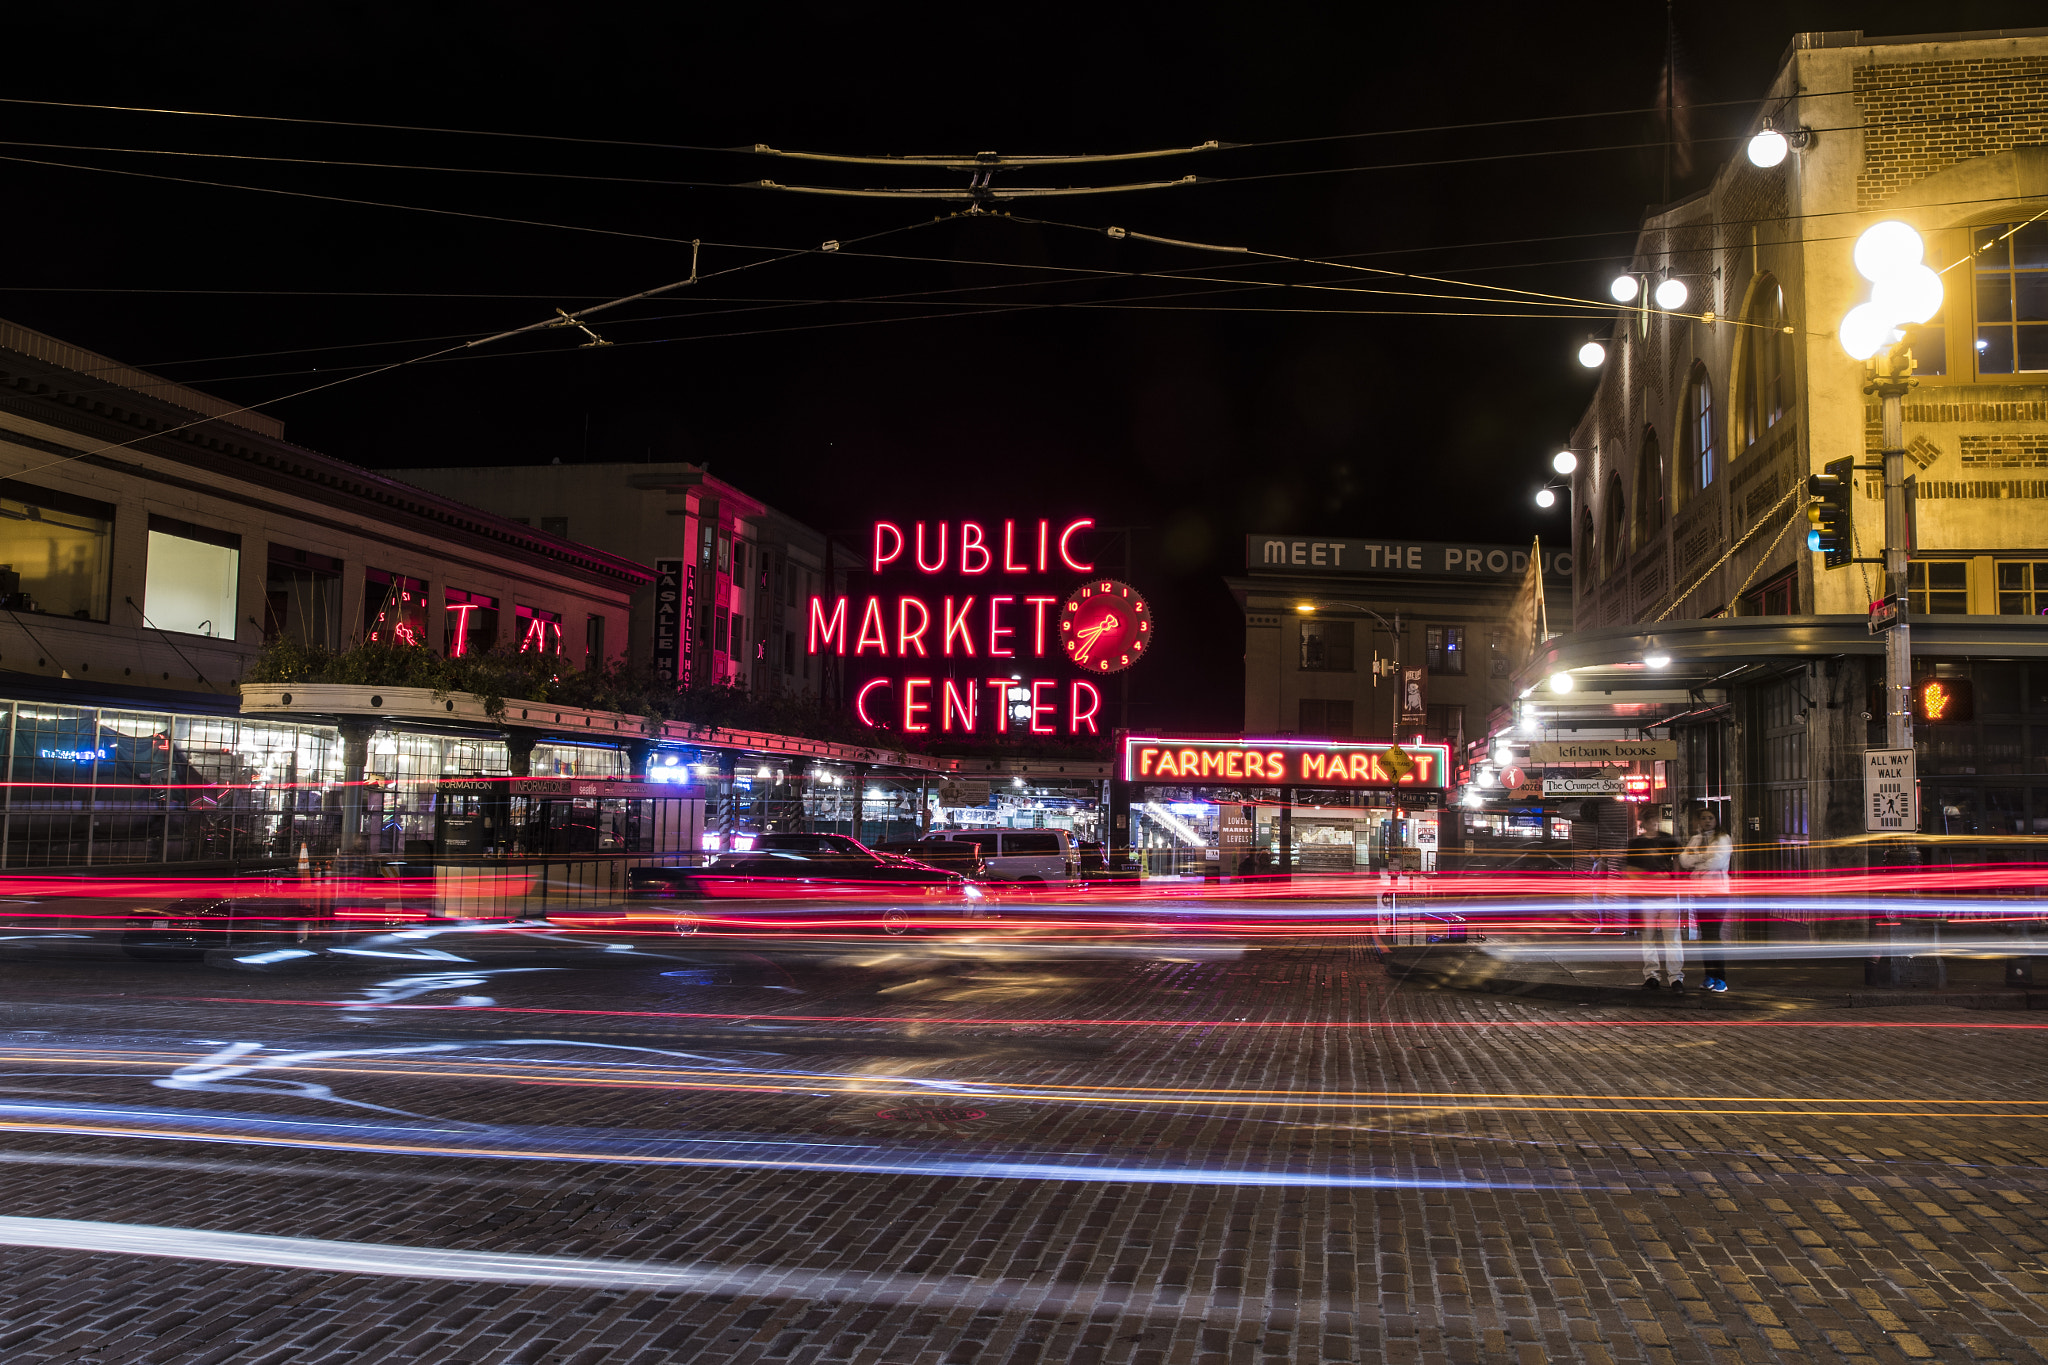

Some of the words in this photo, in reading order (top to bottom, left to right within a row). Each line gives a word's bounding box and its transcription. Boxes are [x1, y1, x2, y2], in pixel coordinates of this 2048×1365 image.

[874, 520, 1093, 573] PUBLIC
[1264, 540, 1346, 566] MEET
[1365, 545, 1422, 569] THE
[660, 564, 676, 586] LA
[688, 567, 695, 589] LA
[1082, 588, 1091, 597] 11
[1101, 583, 1111, 592] 12
[1068, 602, 1078, 611] 10
[1136, 602, 1143, 612] 2
[659, 591, 676, 649] SALLE
[685, 596, 693, 653] SALLE
[808, 596, 1057, 656] MARKET
[1063, 621, 1071, 631] 9
[1140, 621, 1147, 631] 3
[1067, 641, 1075, 650] 8
[1133, 641, 1141, 650] 4
[1121, 655, 1128, 664] 5
[1101, 660, 1108, 670] 6
[857, 678, 1100, 734] CENTER
[1579, 746, 1611, 757] bank
[1615, 745, 1657, 756] books
[1141, 750, 1284, 778] FARMERS
[1870, 756, 1888, 766] ALL
[1890, 755, 1909, 765] WAY
[1878, 768, 1902, 778] WALK
[440, 780, 493, 790] FORMATION
[1517, 783, 1543, 792] ROZEN
[1547, 780, 1563, 791] The
[1564, 780, 1600, 793] Crumpet
[1602, 780, 1626, 793] Shop
[1227, 816, 1248, 825] LOWER
[1226, 835, 1249, 843] LEVELS
